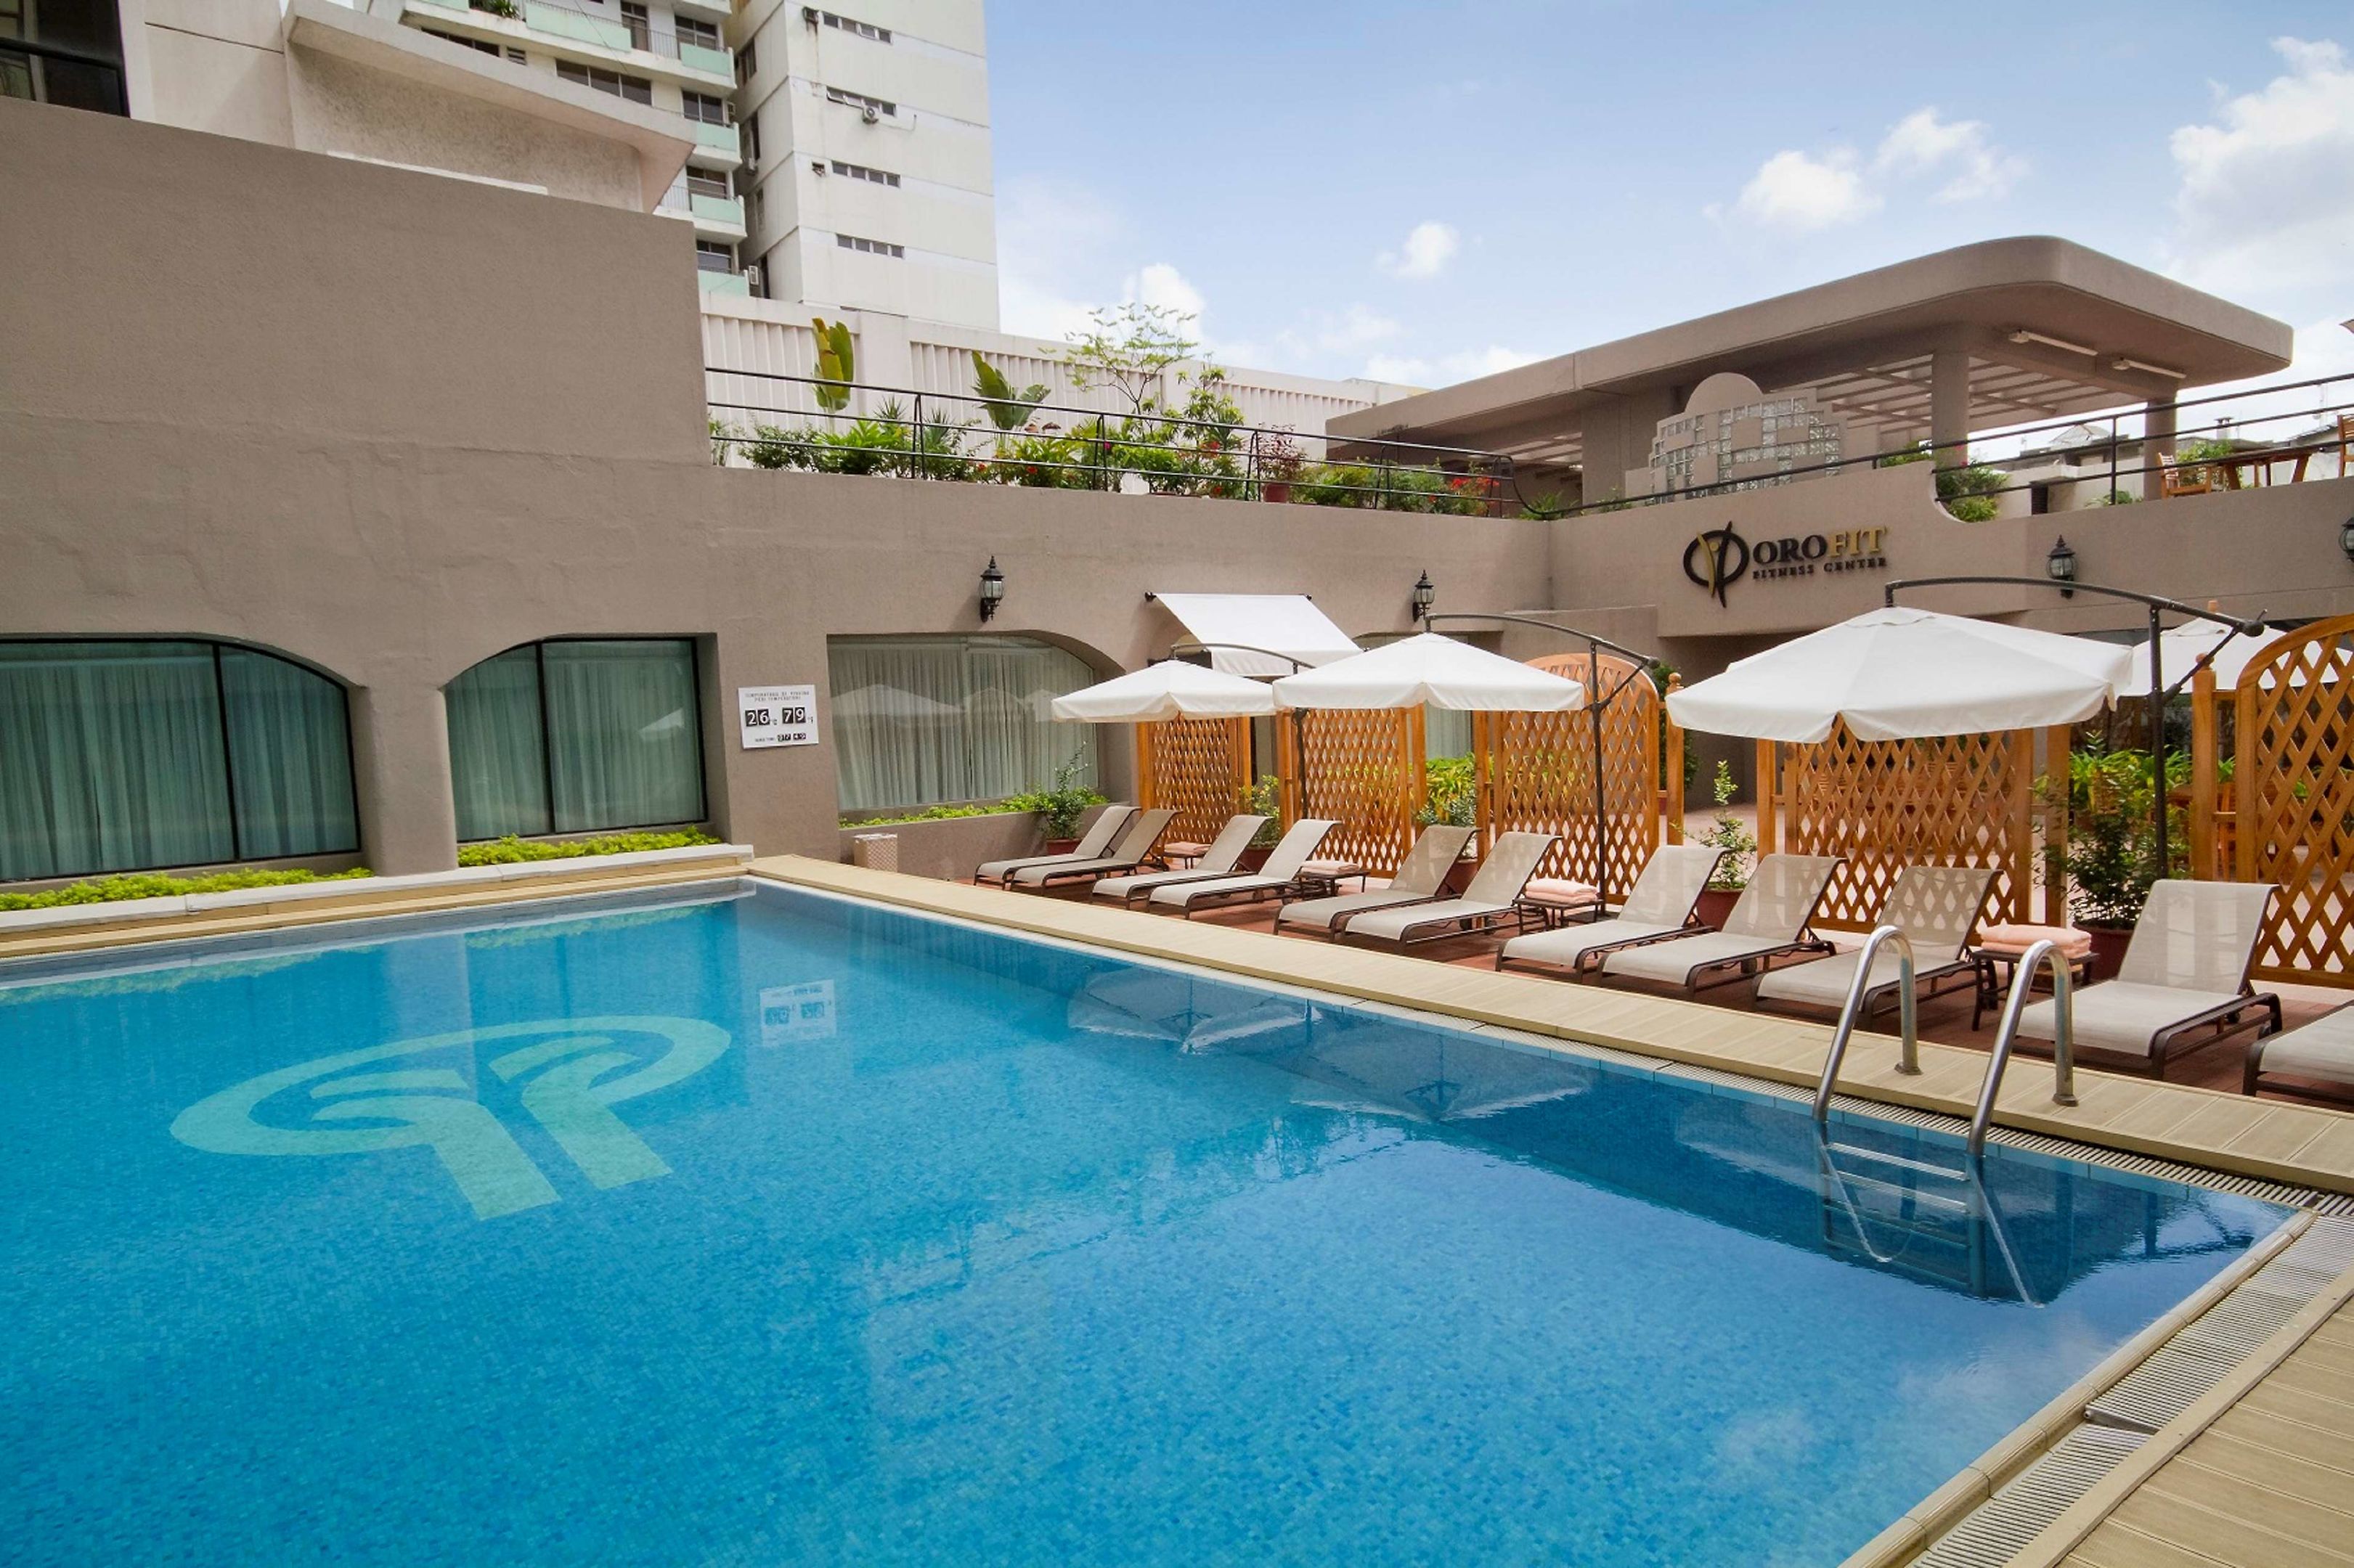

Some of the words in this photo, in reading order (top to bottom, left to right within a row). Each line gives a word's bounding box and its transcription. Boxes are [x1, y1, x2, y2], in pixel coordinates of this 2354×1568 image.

[1753, 526, 1891, 564] OROFIT
[1753, 564, 1814, 579] FITNESS
[1823, 557, 1886, 573] CENTER
